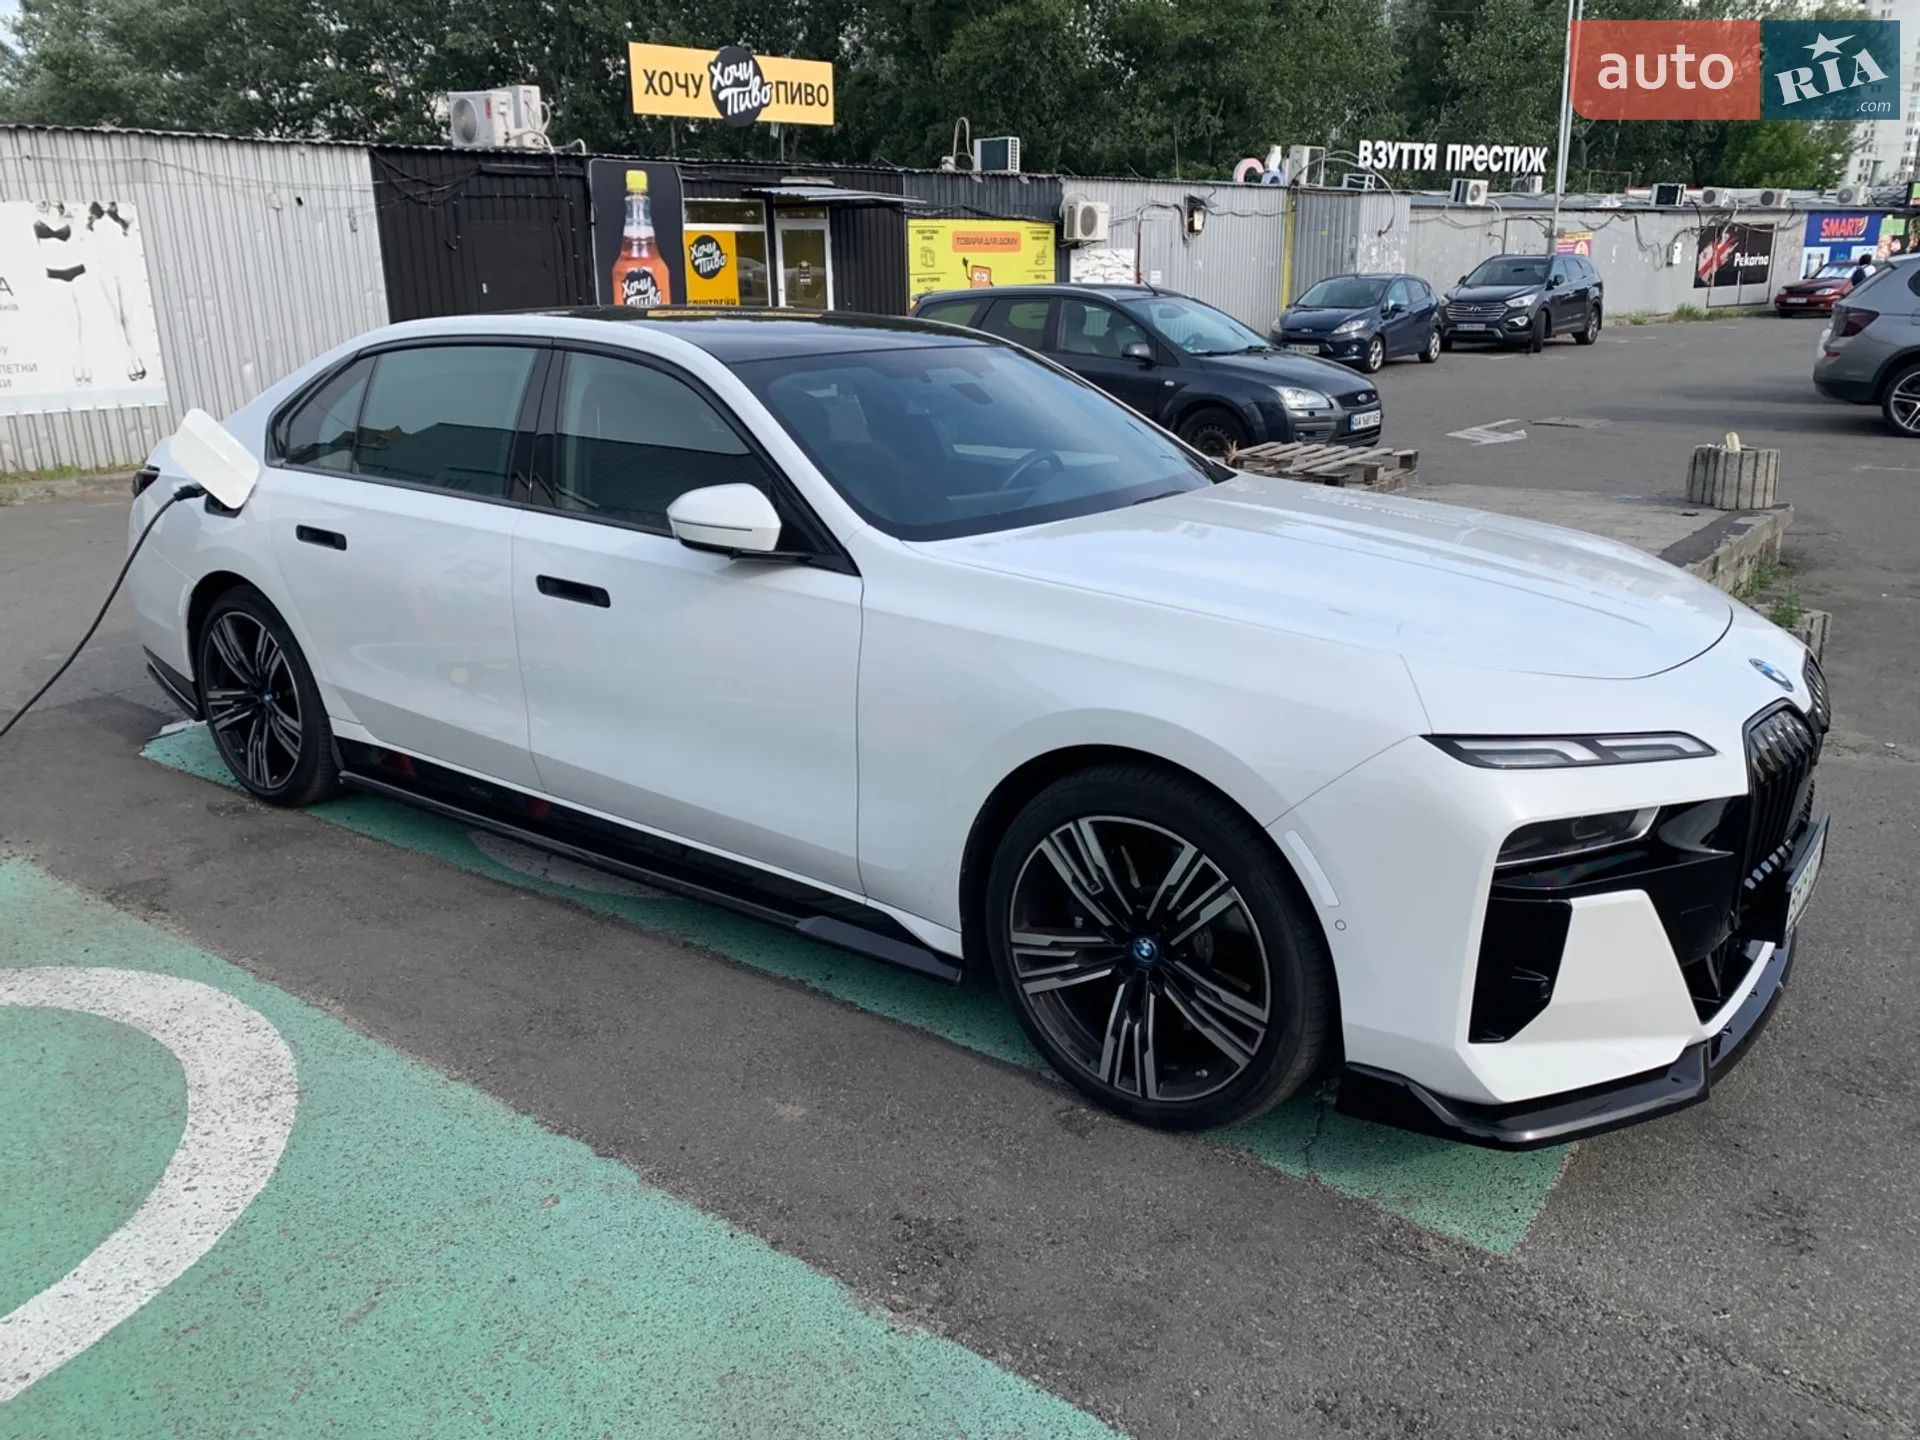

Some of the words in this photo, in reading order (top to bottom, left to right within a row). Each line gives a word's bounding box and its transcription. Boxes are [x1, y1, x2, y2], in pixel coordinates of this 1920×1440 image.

[643, 69, 703, 98] ХОЧУ
[775, 80, 829, 107] ПИВО
[709, 59, 754, 91] Хочу
[718, 75, 772, 116] Пиво
[1358, 140, 1437, 171] ВЗУТТЯ
[956, 237, 983, 246] ТОВАРИ
[984, 237, 998, 246] ДЛЯ
[998, 237, 1019, 246] ДОМУ
[1820, 217, 1860, 237] SMART
